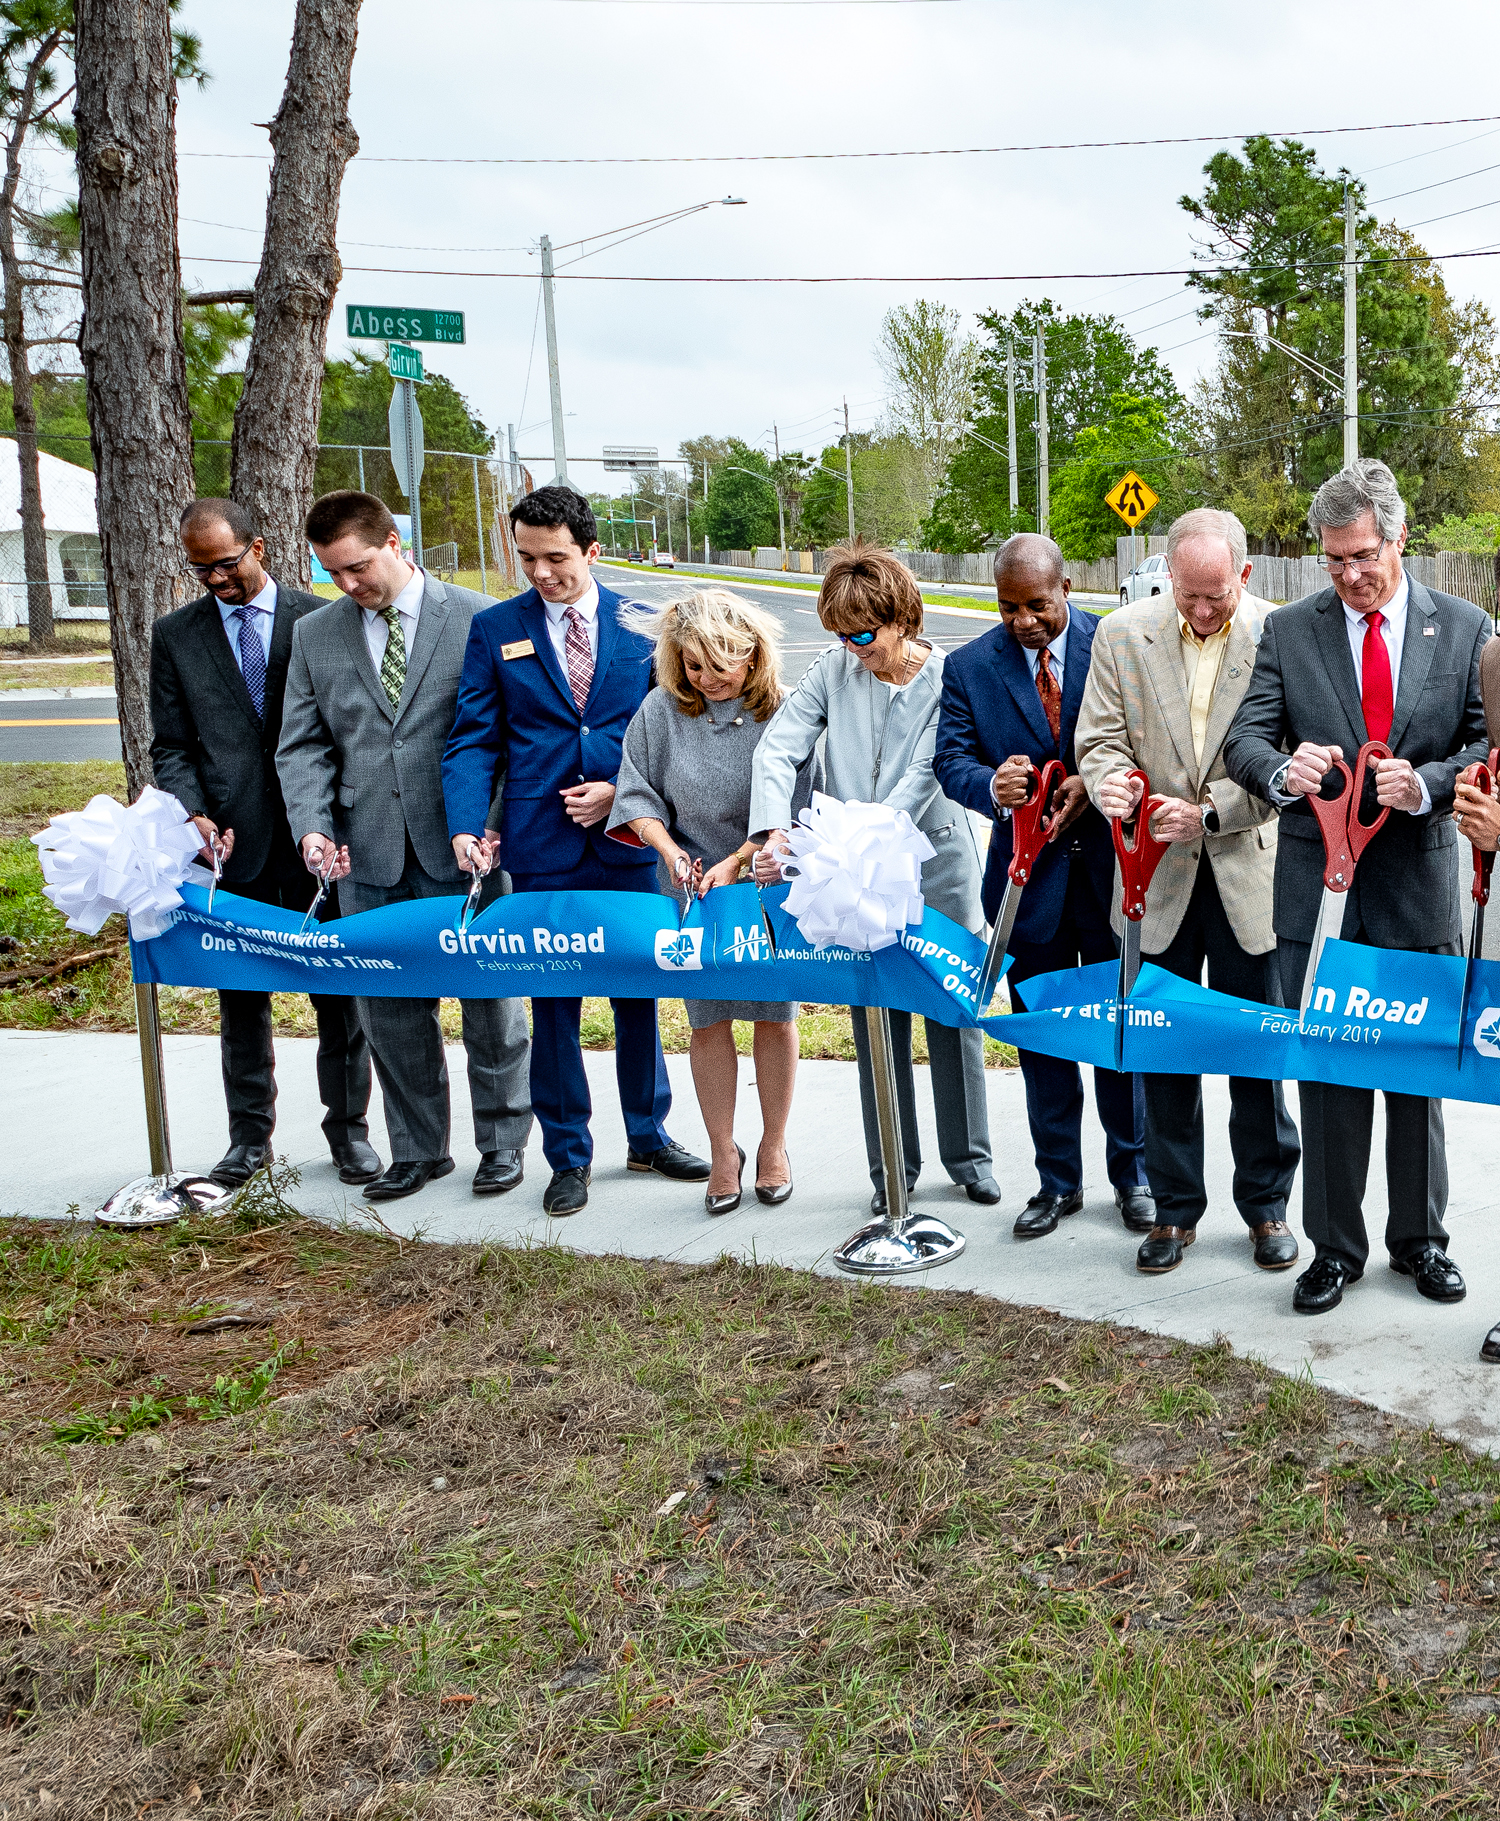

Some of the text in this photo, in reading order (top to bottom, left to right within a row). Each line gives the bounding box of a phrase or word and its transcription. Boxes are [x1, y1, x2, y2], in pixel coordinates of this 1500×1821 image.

[351, 310, 423, 338] Abess
[435, 313, 461, 326] 12700
[435, 328, 462, 341] Blvd
[390, 347, 418, 377] Girvin
[171, 908, 346, 948] proving Communities.
[438, 926, 605, 954] Girvin Road
[201, 932, 402, 970] One Roadway at a Time.
[762, 948, 872, 964] JAMobilityWorks
[900, 929, 981, 984] Improvi
[476, 959, 582, 973] February 2019
[1079, 1003, 1101, 1020] at
[1119, 1004, 1171, 1028] ime.
[1344, 985, 1428, 1026] Road
[1260, 1017, 1382, 1045] February 2019
